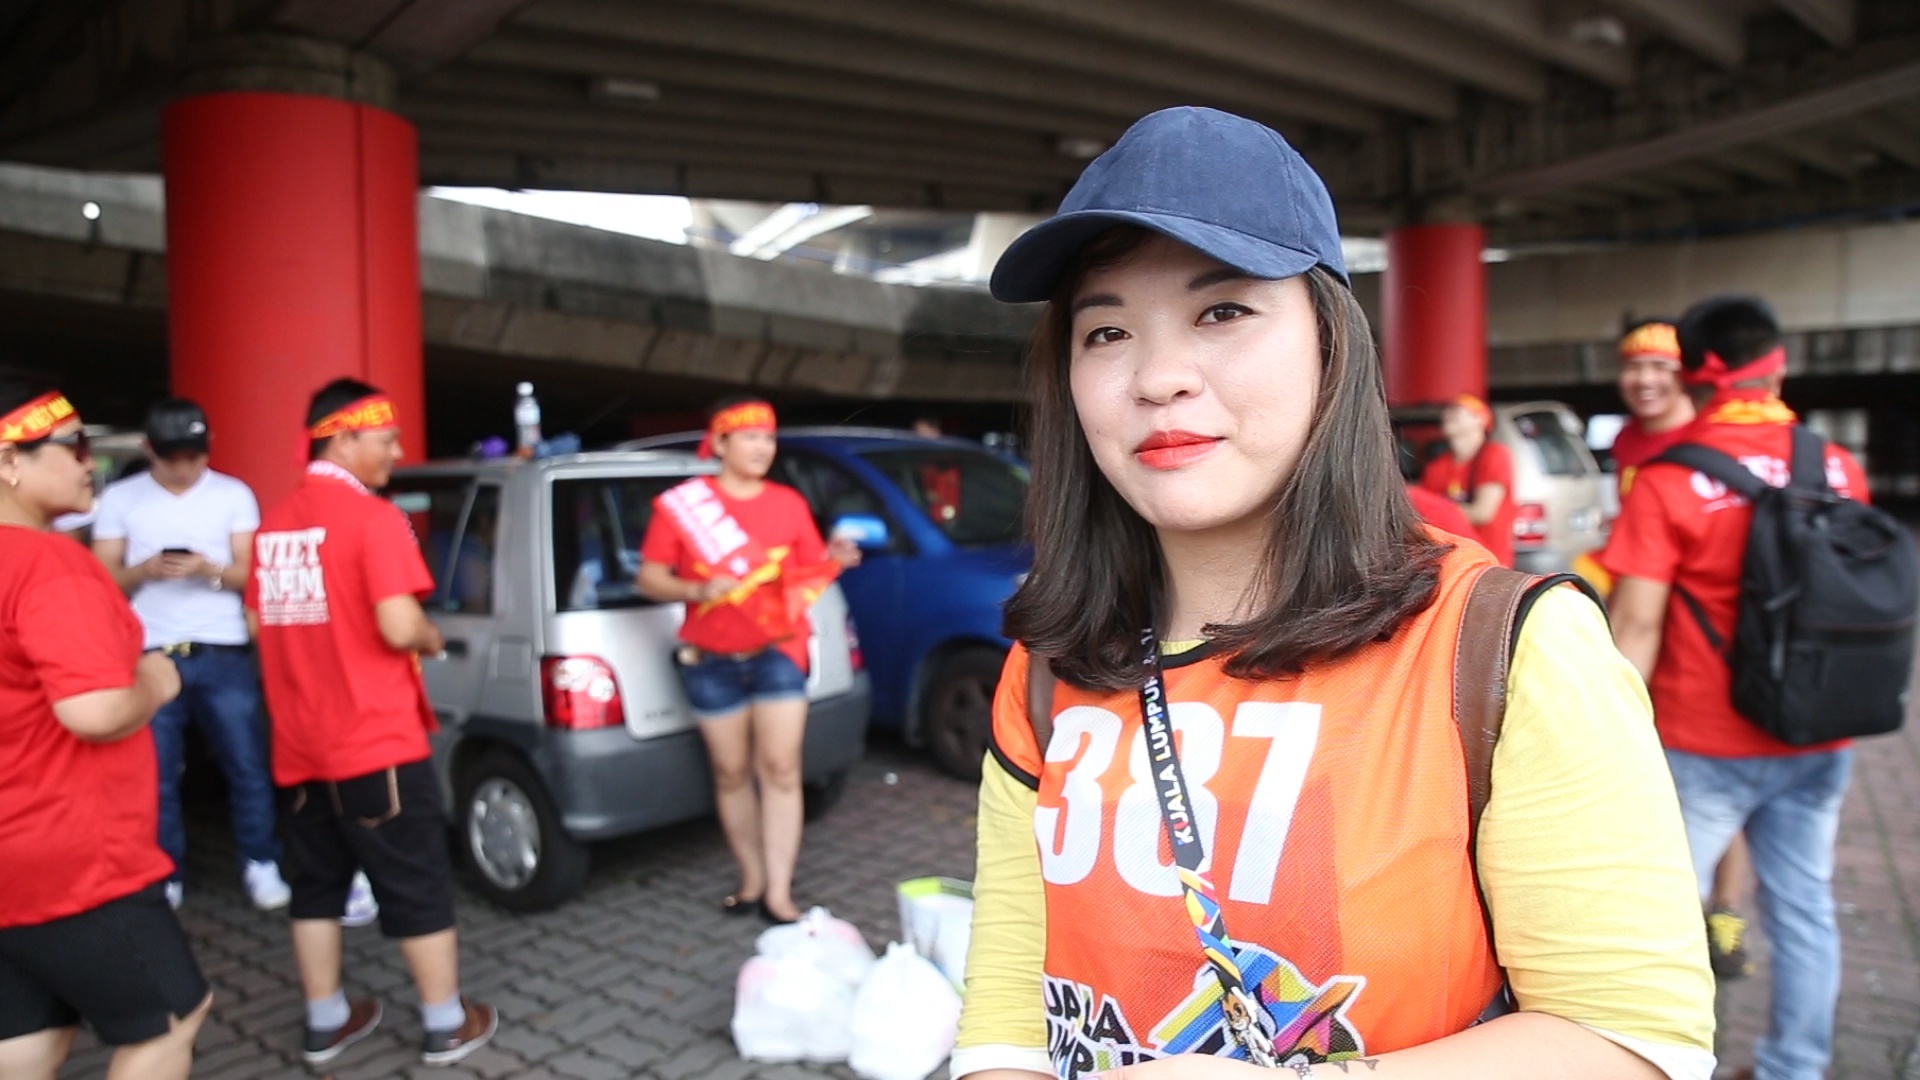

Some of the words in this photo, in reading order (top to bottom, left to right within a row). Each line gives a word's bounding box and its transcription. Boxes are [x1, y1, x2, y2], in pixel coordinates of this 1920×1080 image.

[256, 527, 327, 567] VIET
[255, 565, 327, 602] NAM
[1033, 700, 1323, 905] 387
[1159, 763, 1195, 846] KUALA
[1045, 979, 1132, 1045] UALA
